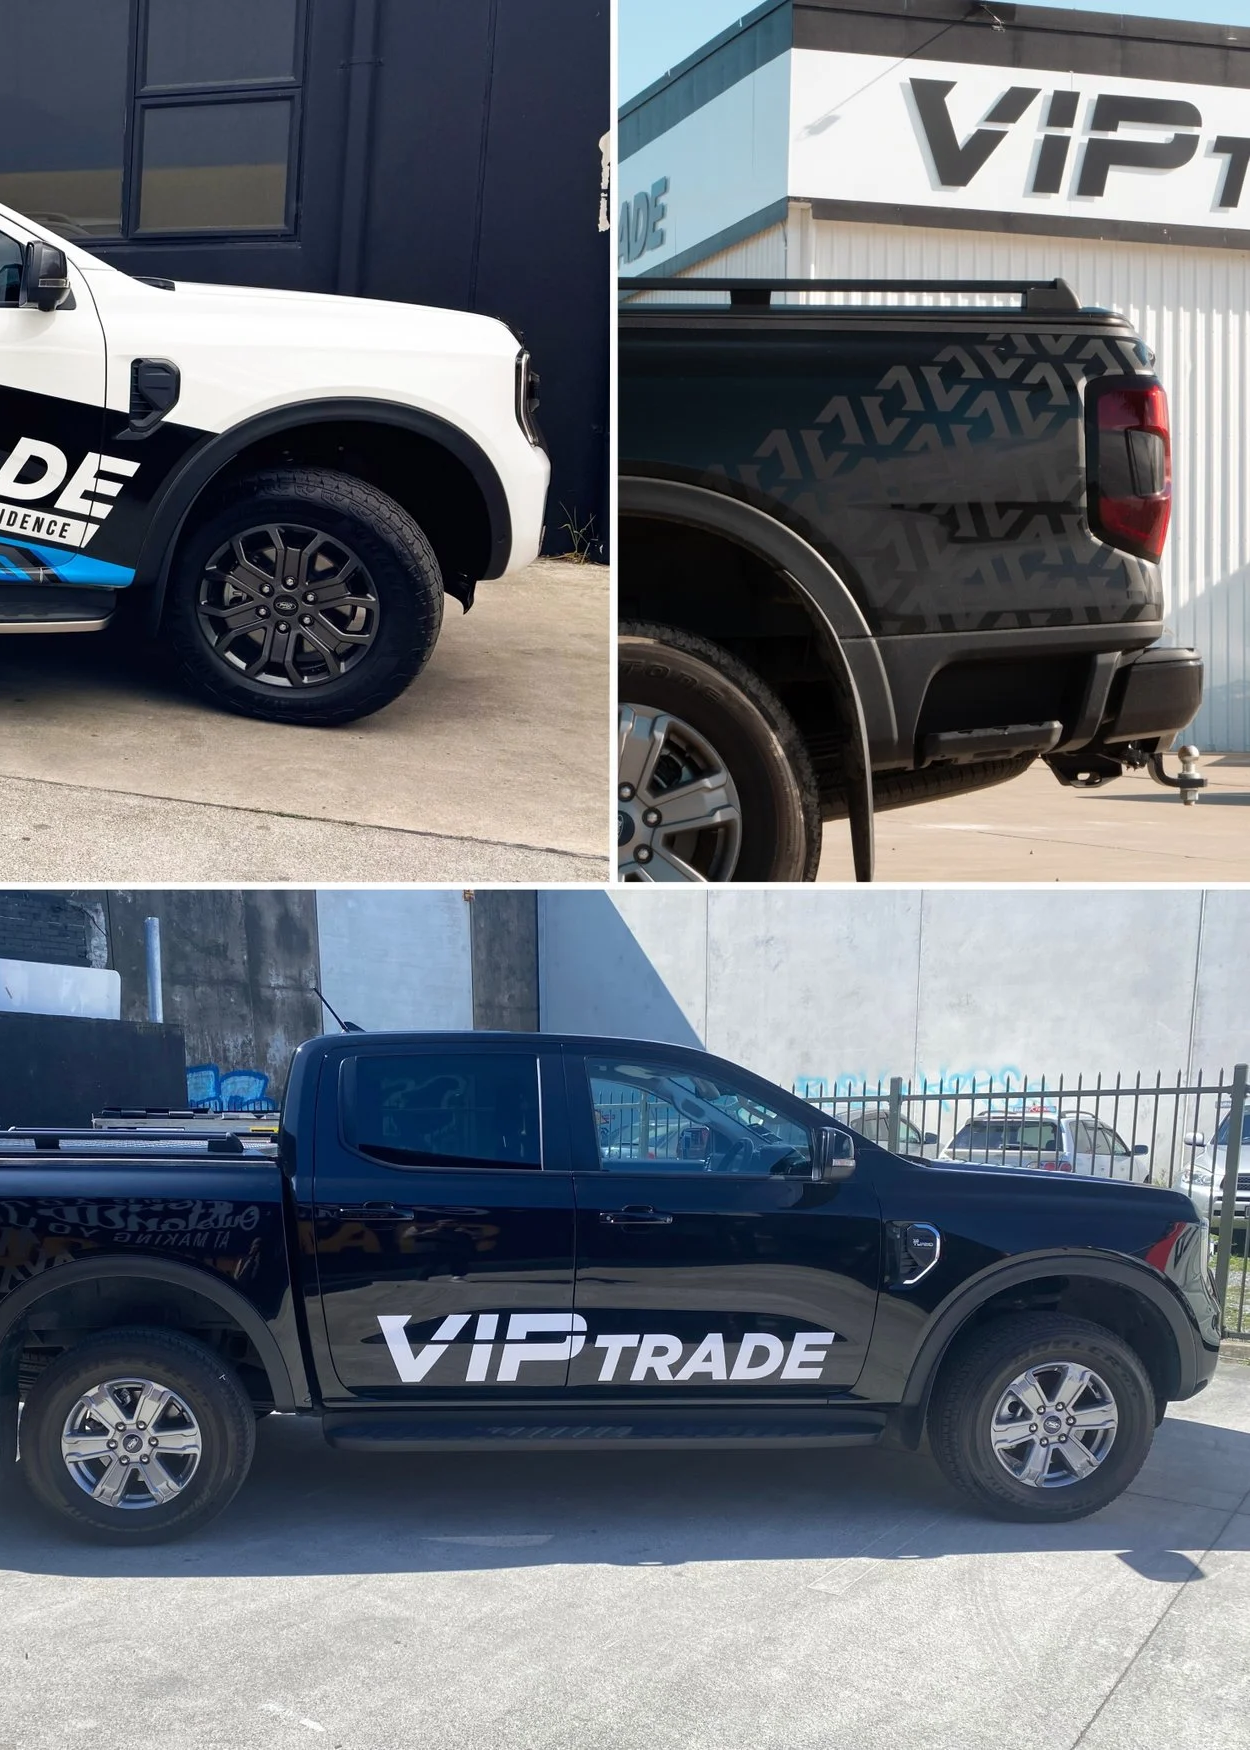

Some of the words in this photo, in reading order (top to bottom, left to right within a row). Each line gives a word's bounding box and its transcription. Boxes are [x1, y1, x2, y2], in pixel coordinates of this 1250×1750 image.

[909, 77, 1203, 197] VIP
[376, 1313, 588, 1383] VIP
[593, 1332, 835, 1382] TRADE
